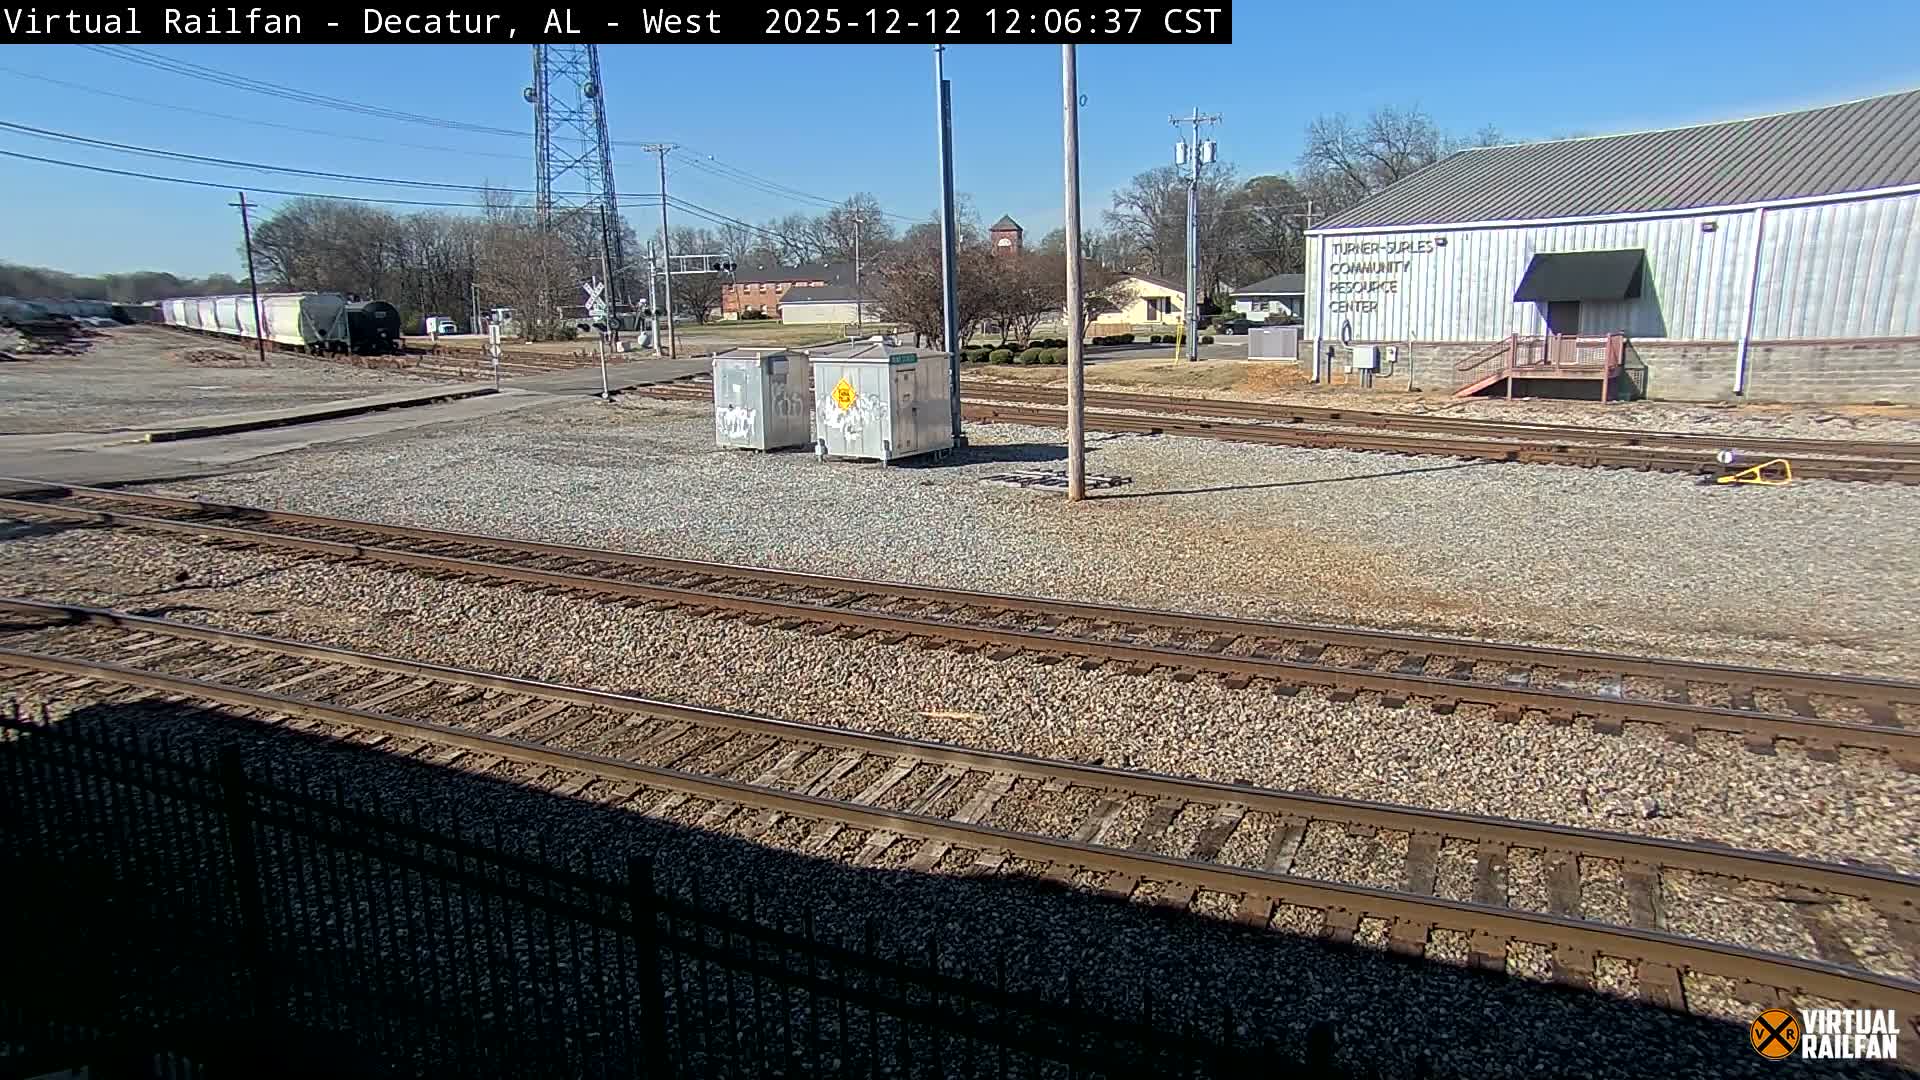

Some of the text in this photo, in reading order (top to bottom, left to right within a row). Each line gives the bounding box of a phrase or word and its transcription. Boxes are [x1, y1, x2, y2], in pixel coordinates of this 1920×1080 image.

[1329, 260, 1411, 275] COMMUNITY
[1329, 280, 1398, 294] RESOURCE
[1328, 300, 1378, 313] CENTER
